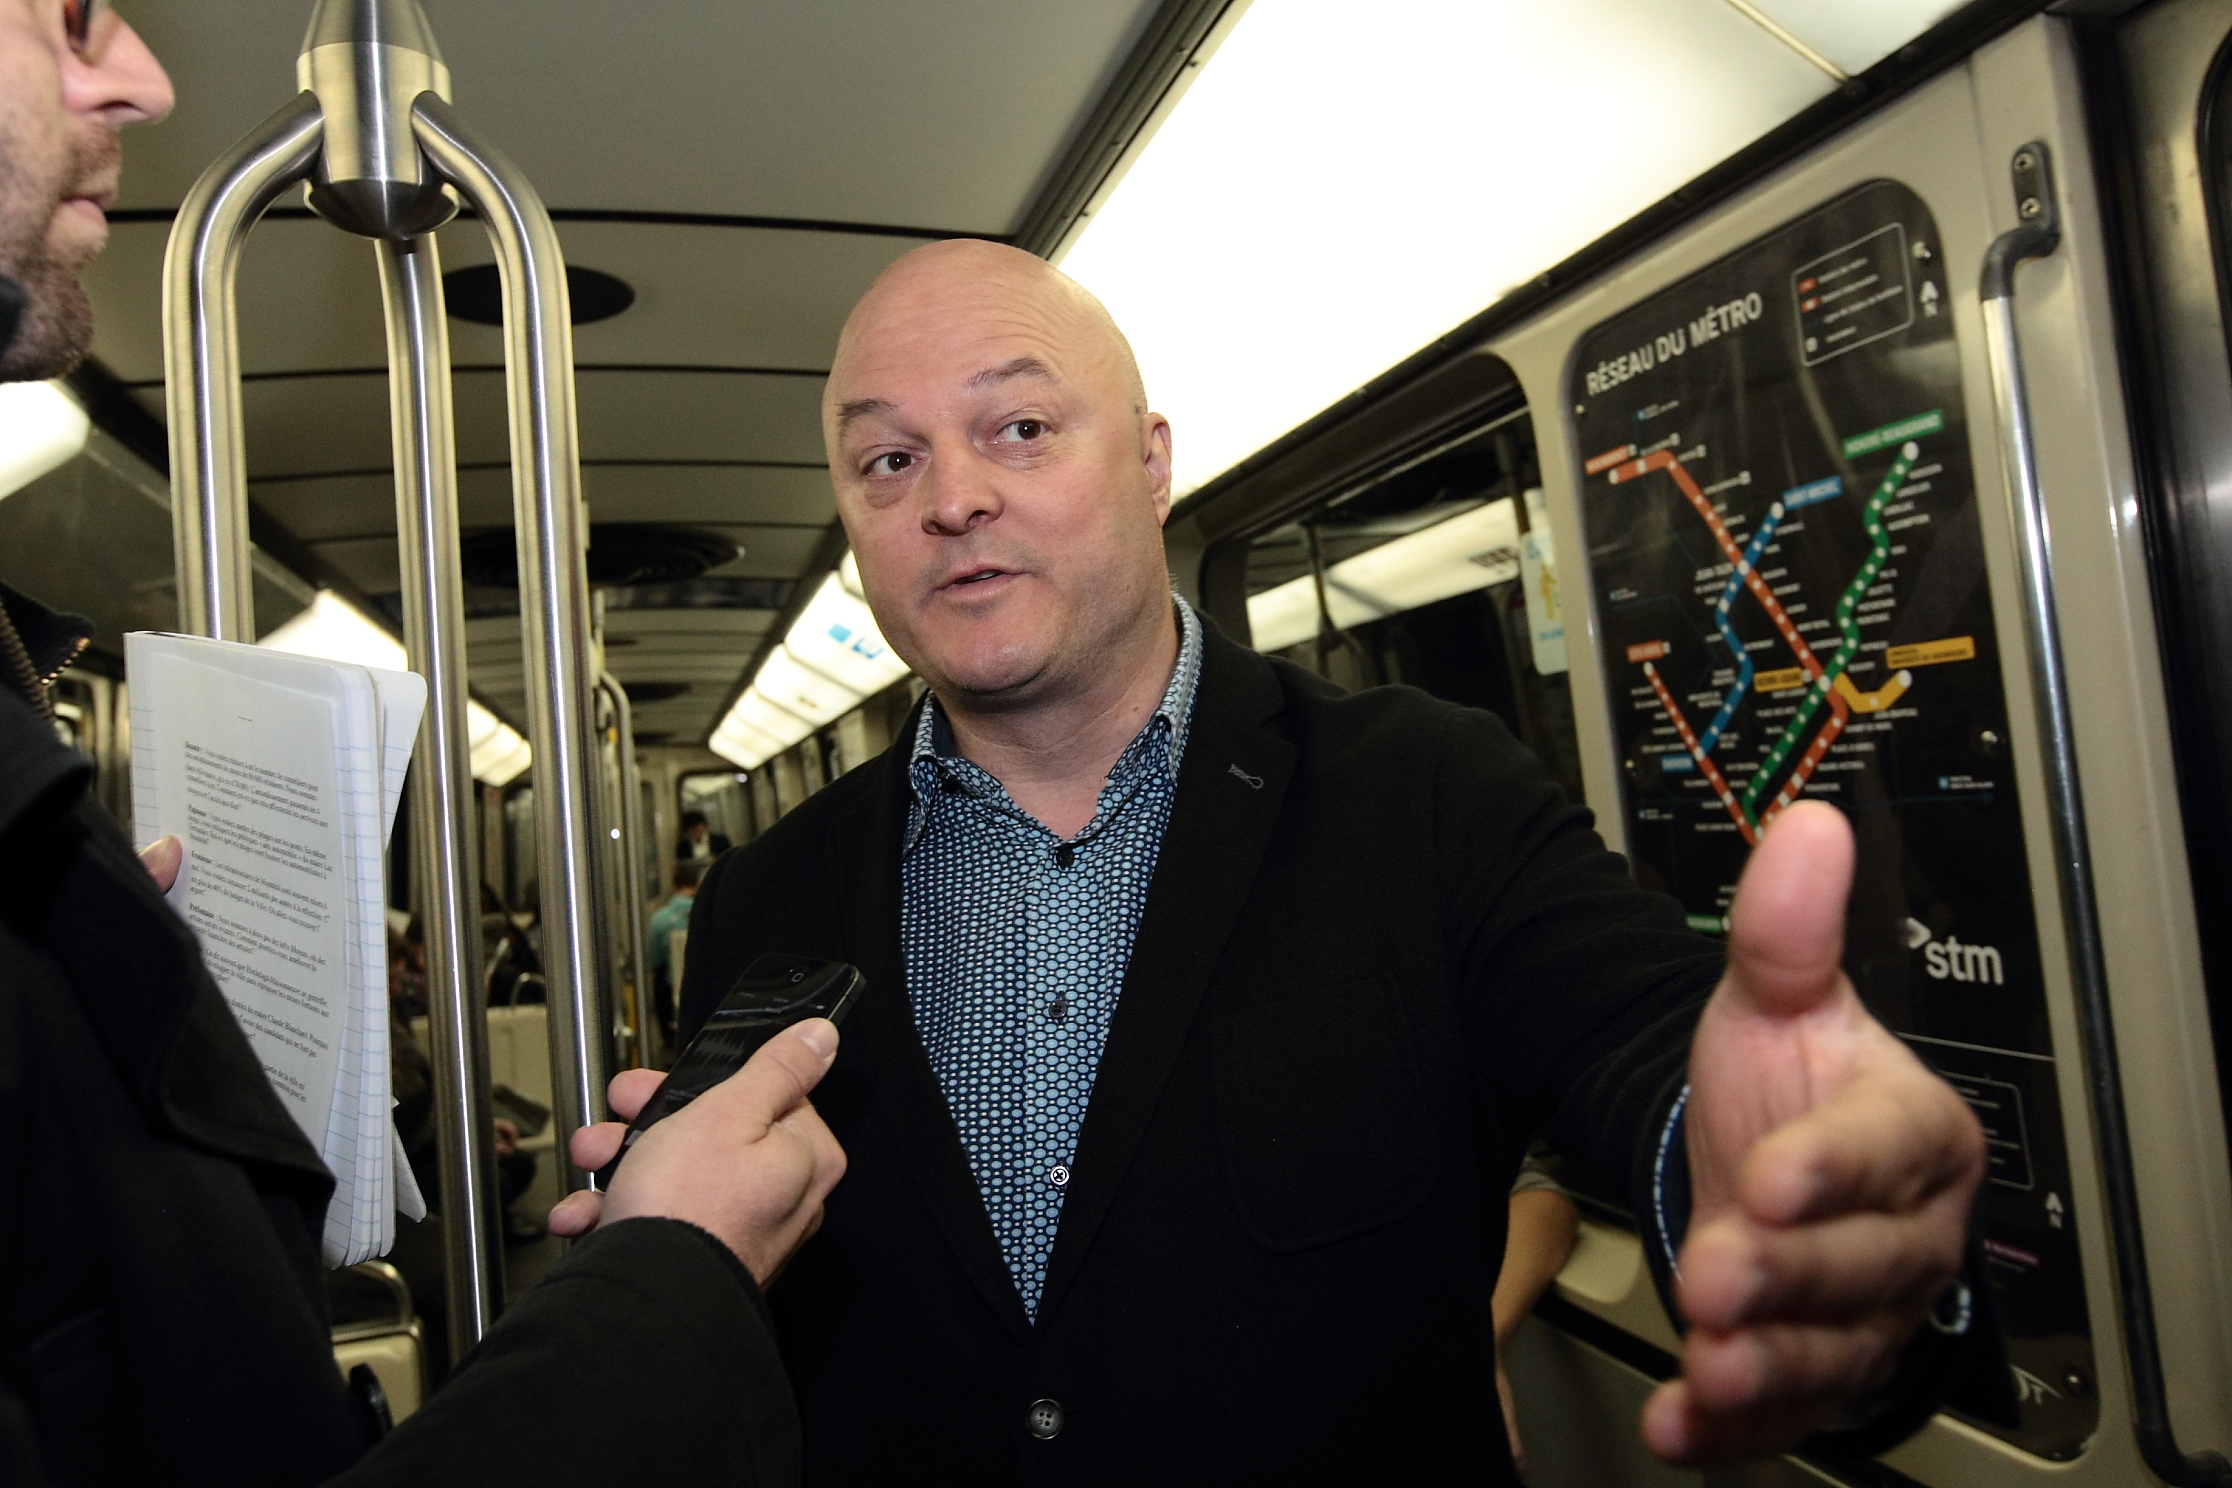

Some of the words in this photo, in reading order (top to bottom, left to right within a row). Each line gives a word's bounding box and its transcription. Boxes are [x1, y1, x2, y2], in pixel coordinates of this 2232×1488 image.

[1585, 343, 1655, 396] RÉSEAU
[1654, 328, 1686, 364] DU
[1688, 291, 1763, 348] MÉTRO
[1925, 935, 2004, 985] stm
